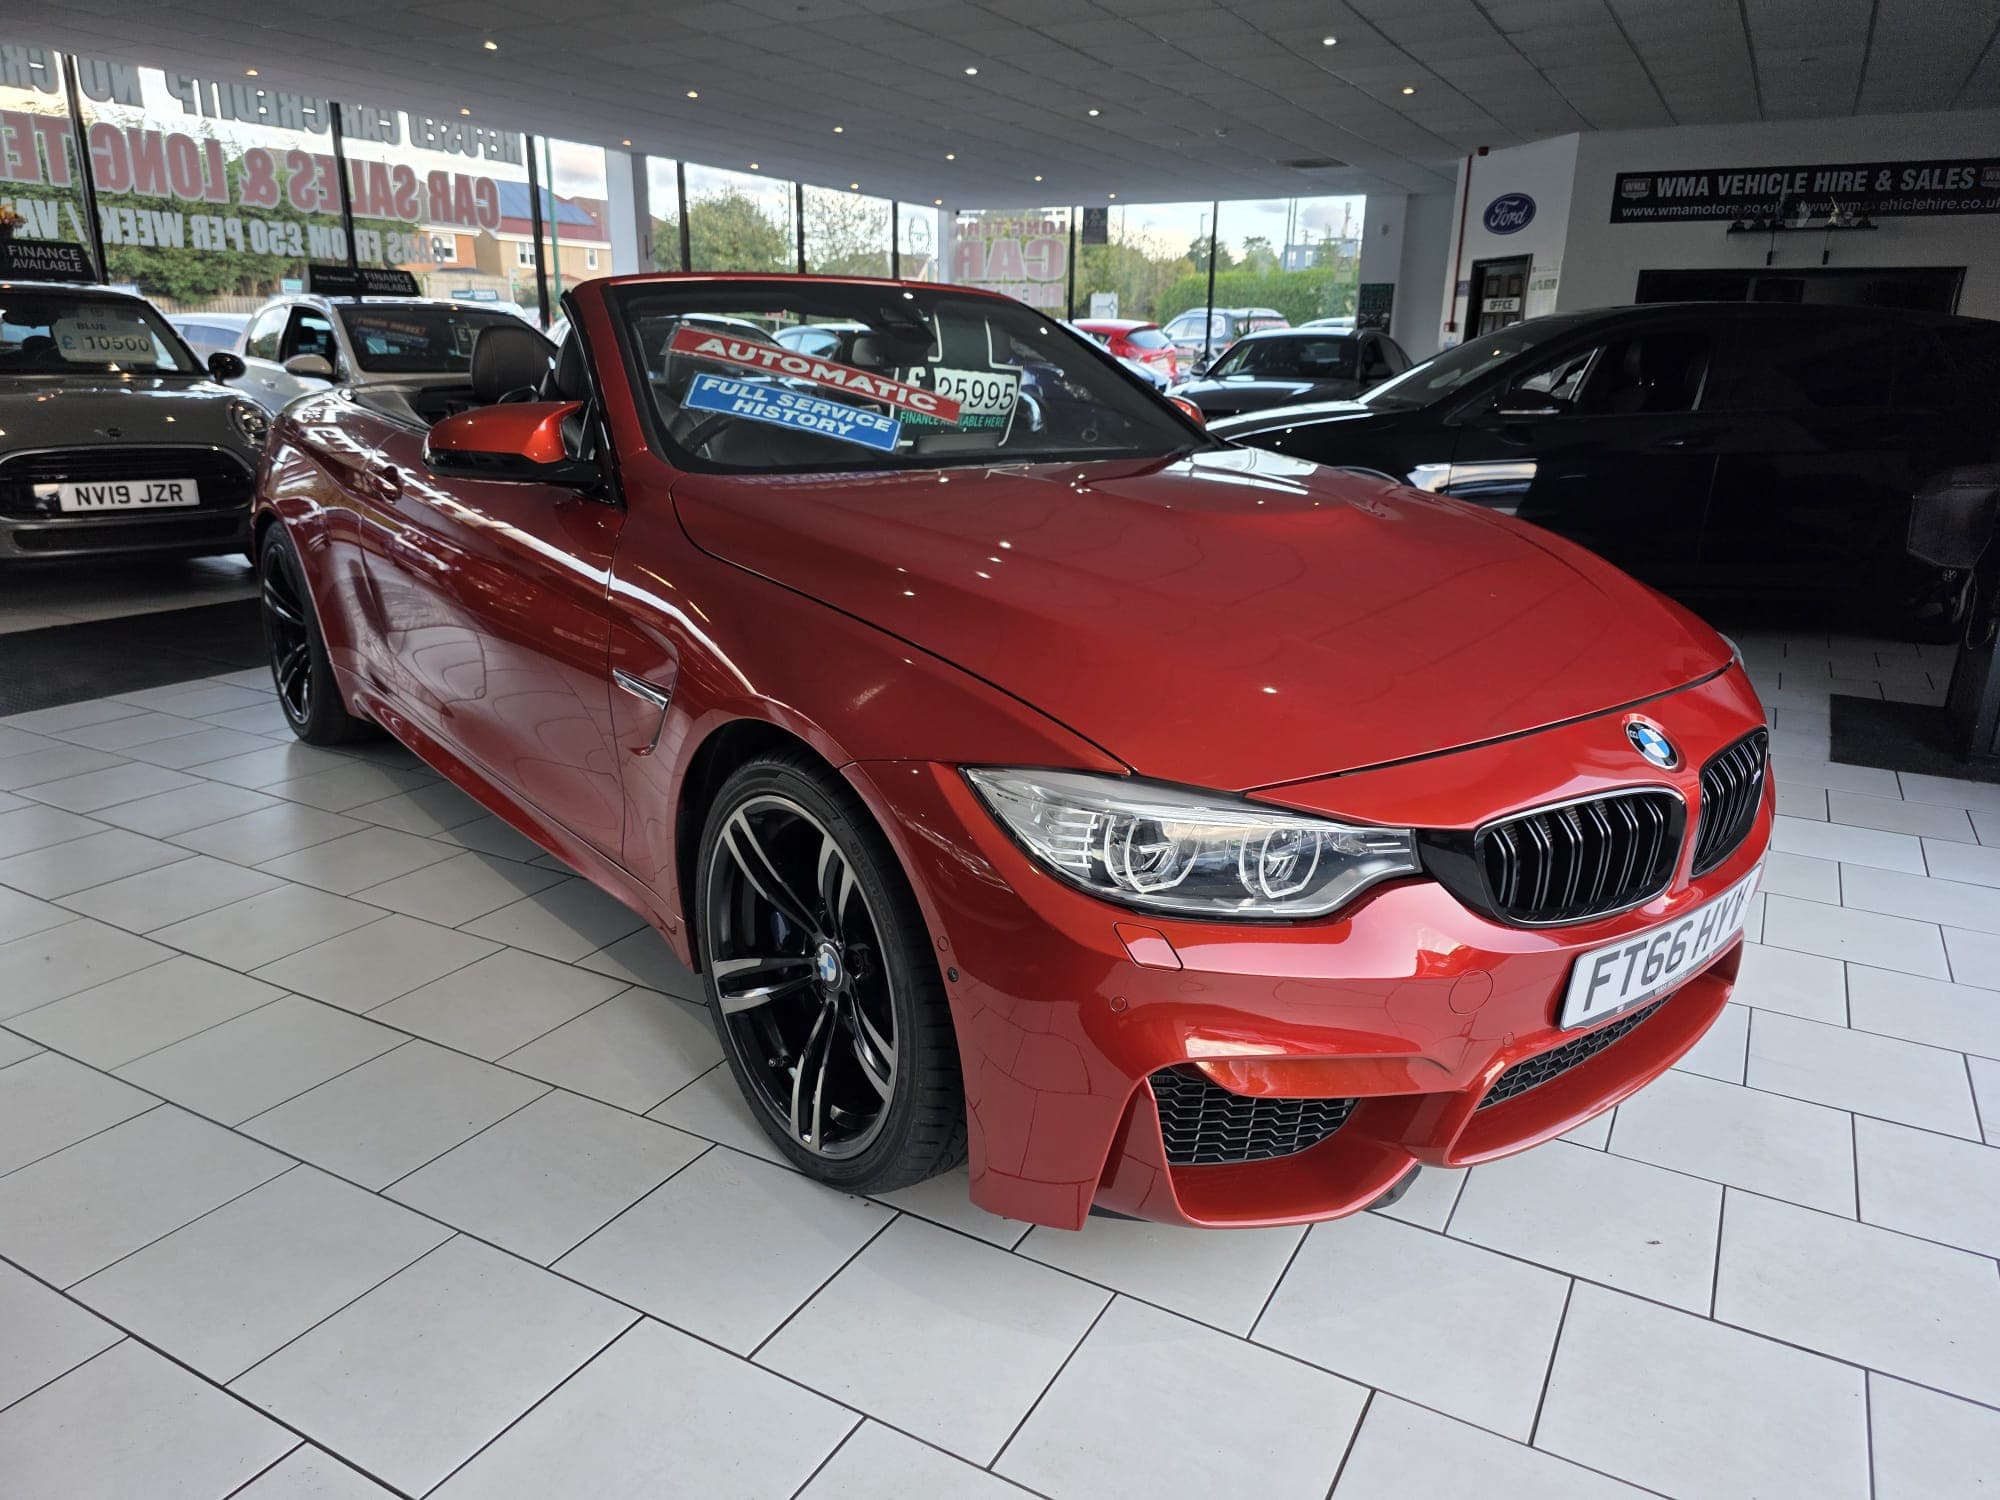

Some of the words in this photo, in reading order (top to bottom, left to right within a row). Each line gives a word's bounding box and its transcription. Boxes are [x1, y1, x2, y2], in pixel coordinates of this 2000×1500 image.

[1657, 175, 1709, 197] WMA
[1718, 172, 1808, 195] VEHICLE
[1814, 171, 1868, 193] HIRE
[1875, 169, 1893, 191] &
[1900, 167, 1976, 191] SALES
[1490, 199, 1528, 228] Ford
[8, 245, 80, 261] FINANCE
[13, 258, 83, 273] AVAILABLE
[364, 271, 410, 283] FINANCE
[368, 281, 414, 293] AVAILABLE
[1490, 299, 1513, 311] OFFICE
[62, 335, 76, 350] £
[85, 335, 150, 353] 10500
[695, 338, 938, 412] AUTOMATIC
[701, 378, 771, 403] FULL
[776, 393, 893, 432] SERVICE
[938, 376, 1016, 410] 25995
[731, 398, 856, 436] HISTORY
[984, 416, 1007, 429] HERE
[75, 484, 130, 507] NV19
[140, 482, 184, 504] JZR
[1583, 919, 1694, 1013] FT66
